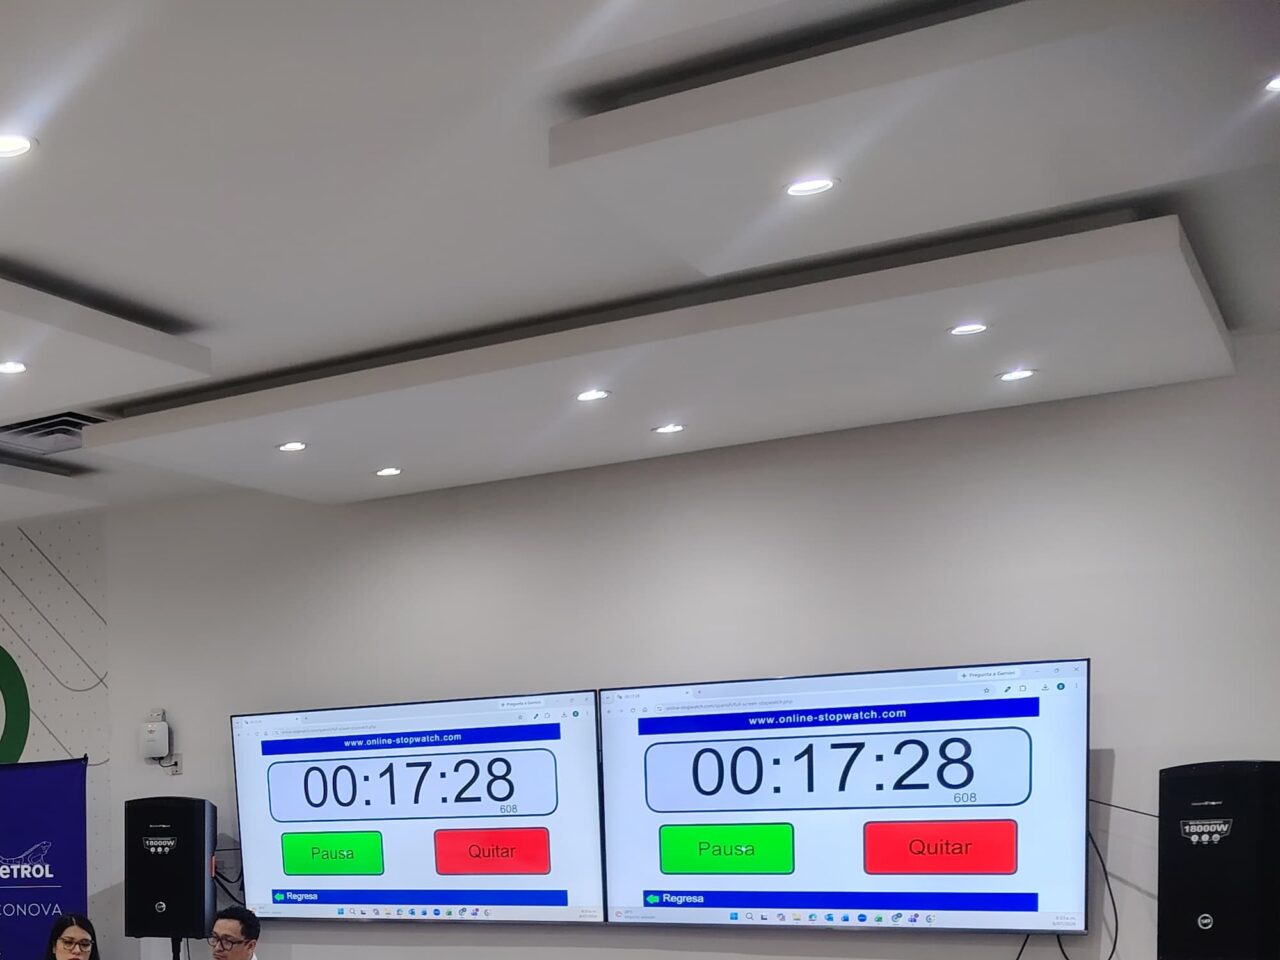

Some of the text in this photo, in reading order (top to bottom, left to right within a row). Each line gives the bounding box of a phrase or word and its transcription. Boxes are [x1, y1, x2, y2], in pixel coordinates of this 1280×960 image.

[749, 708, 907, 725] www.online-stopwatch.com
[343, 733, 462, 747] www.online-stopwatch.com
[692, 737, 975, 796] 00:17:28
[303, 757, 515, 808] 00:17:28
[953, 792, 977, 803] 608
[499, 804, 518, 814] 608
[311, 844, 516, 860] Pausa Quitar
[698, 838, 972, 856] Pausa Quitar
[286, 892, 318, 902] Regresa
[663, 893, 704, 904] Regresa
